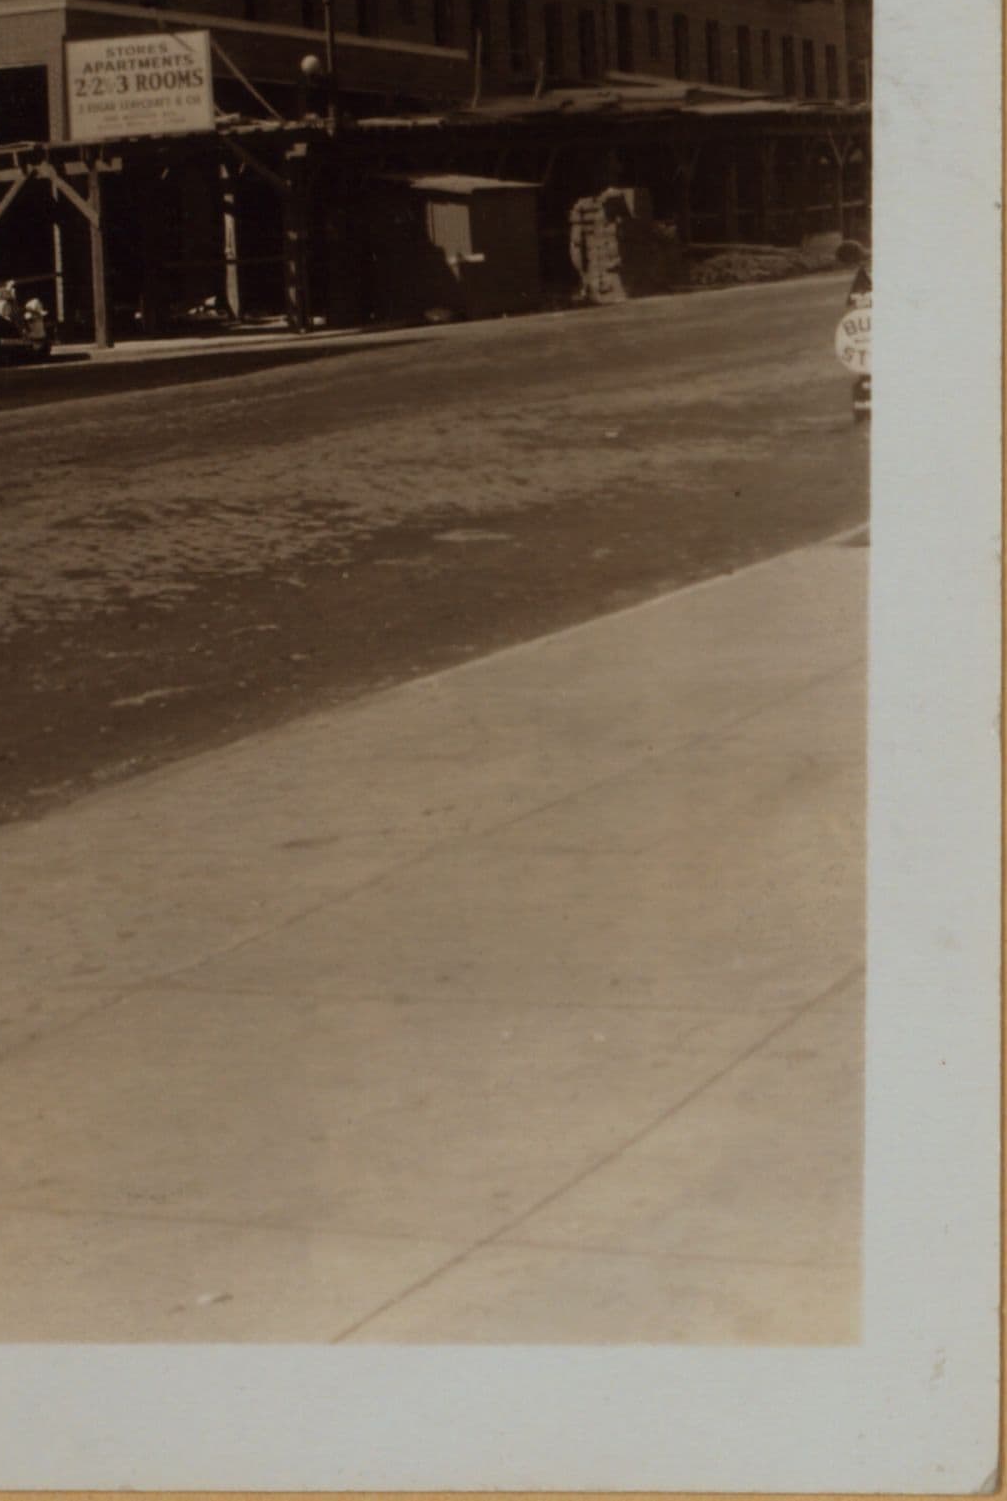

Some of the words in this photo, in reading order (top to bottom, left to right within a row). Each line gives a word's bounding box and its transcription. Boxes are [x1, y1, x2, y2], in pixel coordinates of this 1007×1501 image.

[106, 43, 168, 58] STORES
[83, 54, 194, 74] APARTMENTS
[135, 68, 204, 92] ROOMS
[842, 316, 871, 336] BU
[841, 345, 866, 365] ST
